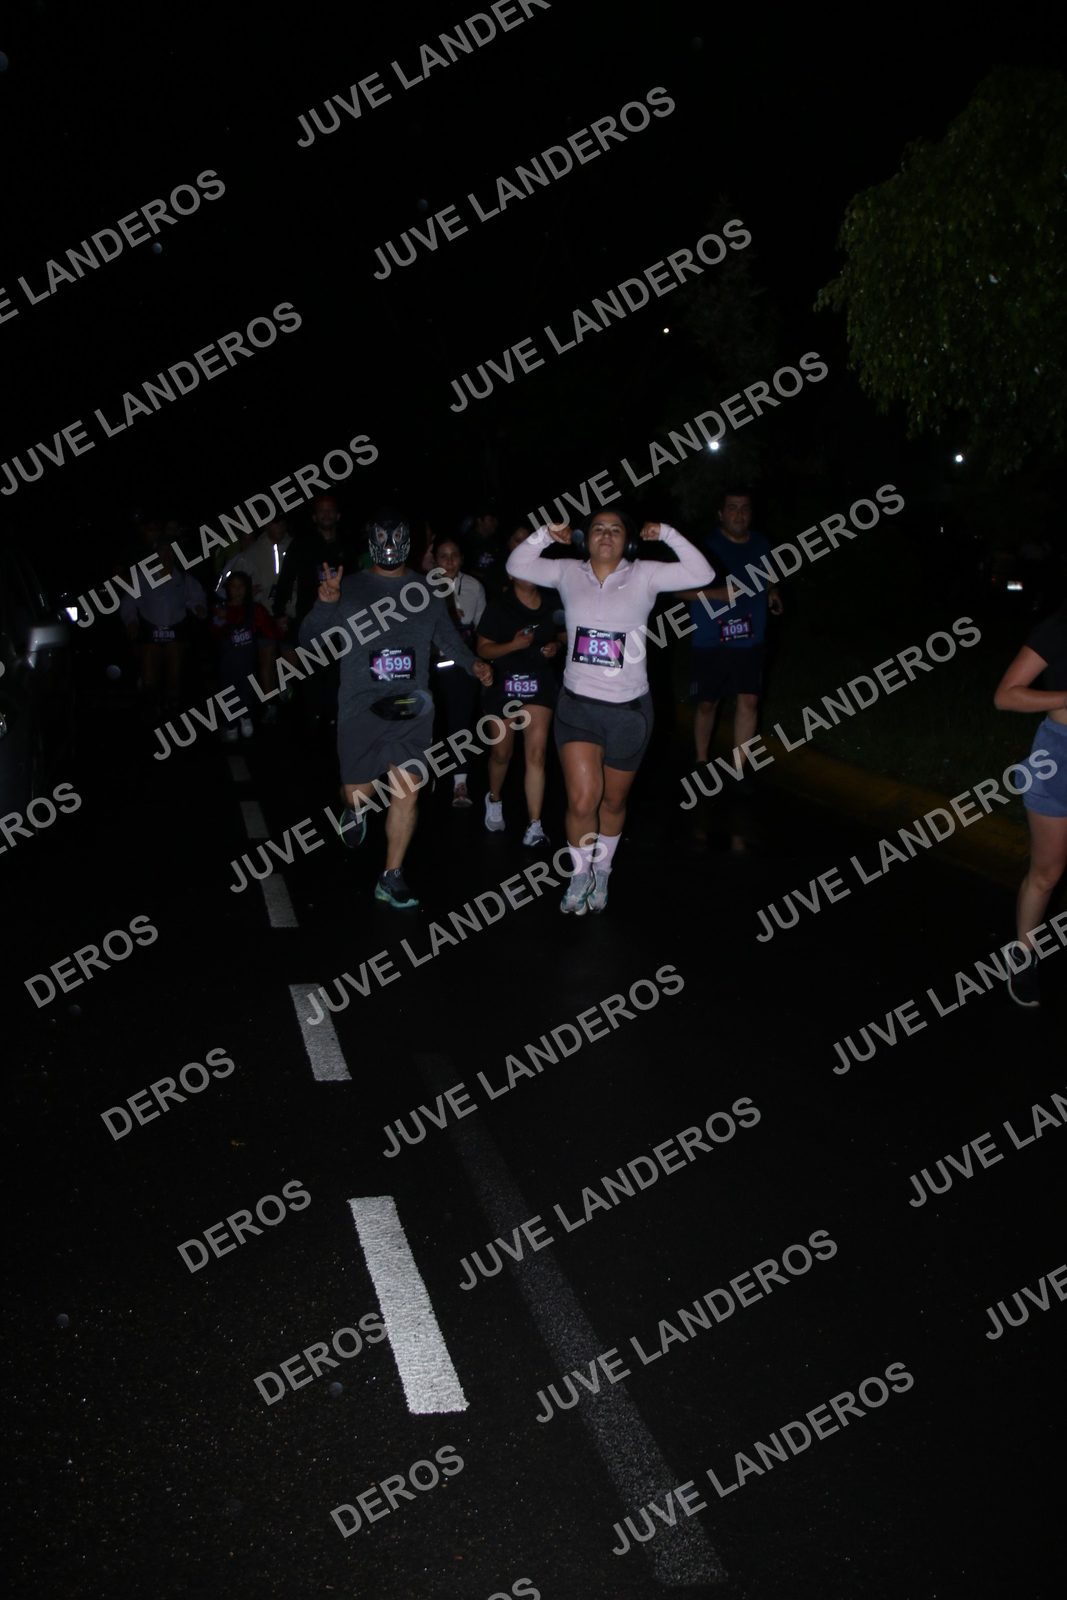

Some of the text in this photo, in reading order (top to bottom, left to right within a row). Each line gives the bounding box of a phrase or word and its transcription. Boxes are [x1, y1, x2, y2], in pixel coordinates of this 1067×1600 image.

[723, 622, 749, 636] 1091
[588, 639, 609, 656] 83
[375, 656, 412, 673] 1599
[507, 680, 539, 693] 1635
